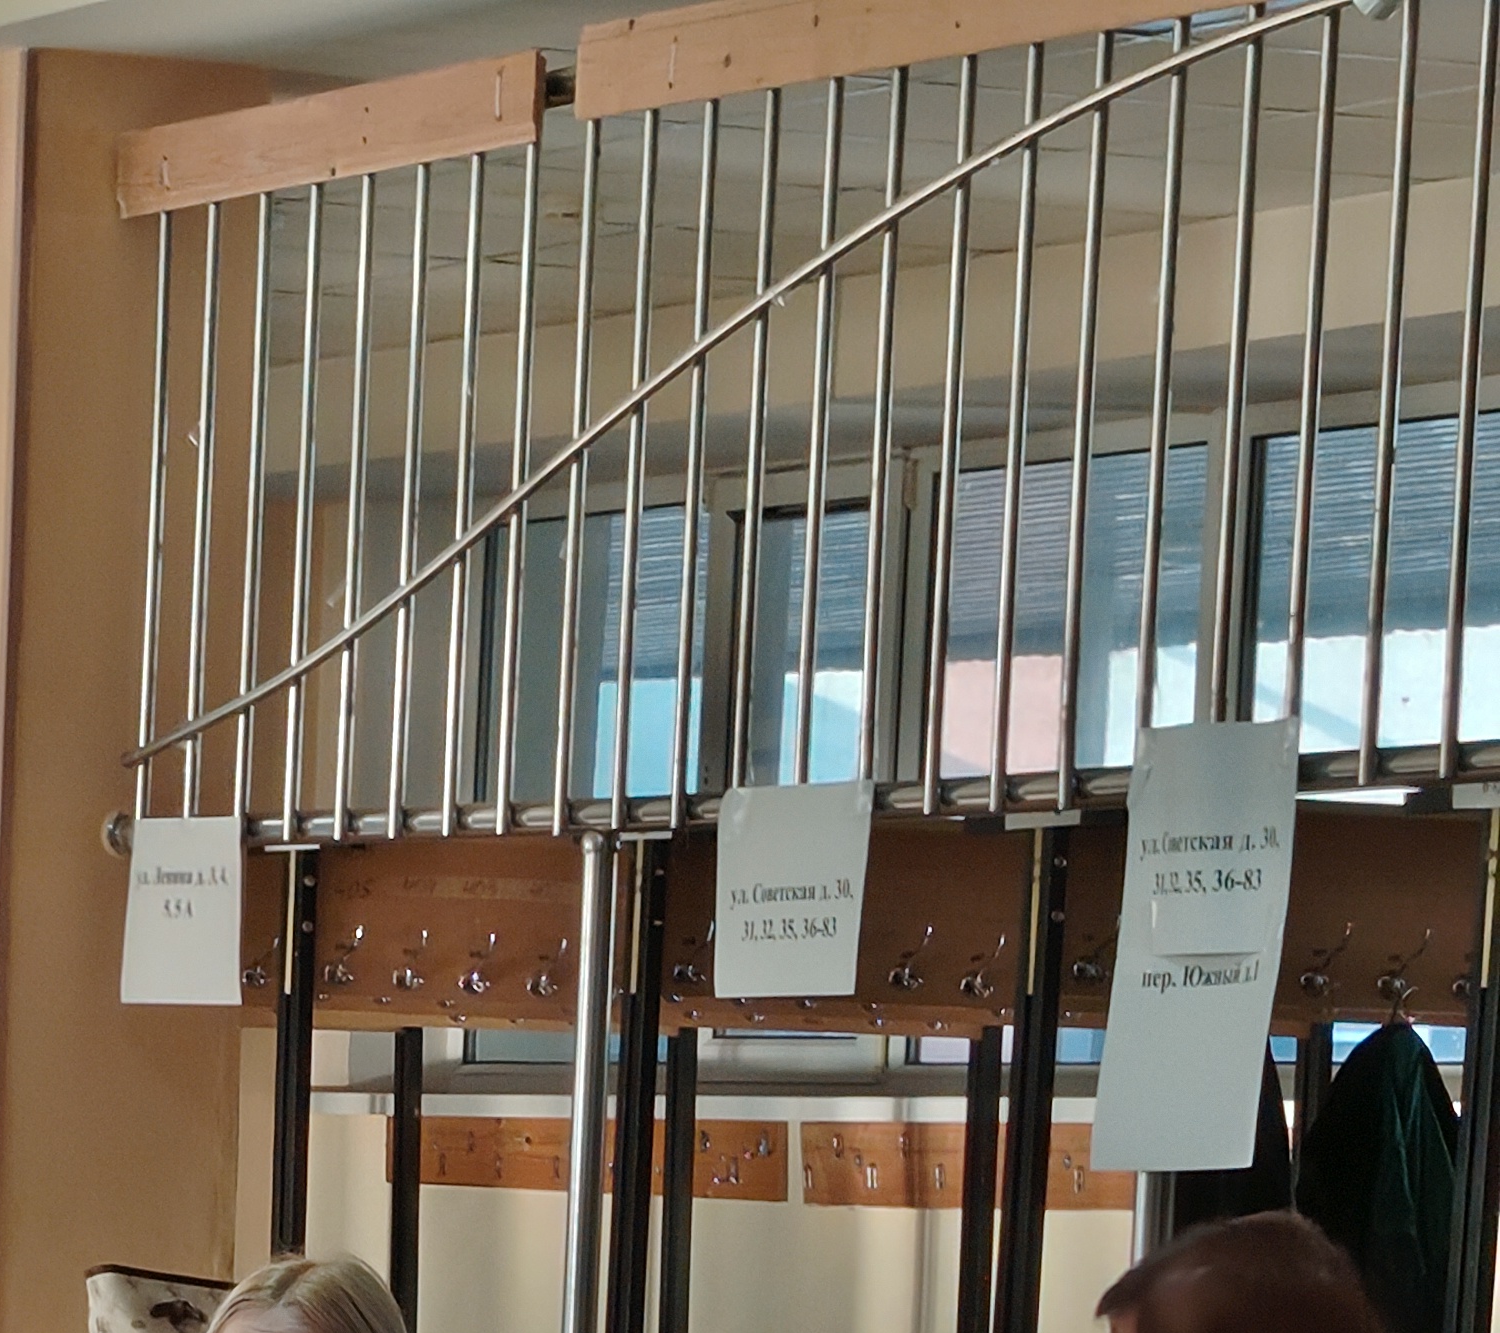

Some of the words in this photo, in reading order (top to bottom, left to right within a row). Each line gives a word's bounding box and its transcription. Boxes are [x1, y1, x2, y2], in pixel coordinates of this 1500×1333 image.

[1239, 833, 1256, 854] д.
[1211, 868, 1262, 893] 36-83
[752, 882, 816, 904] Советская
